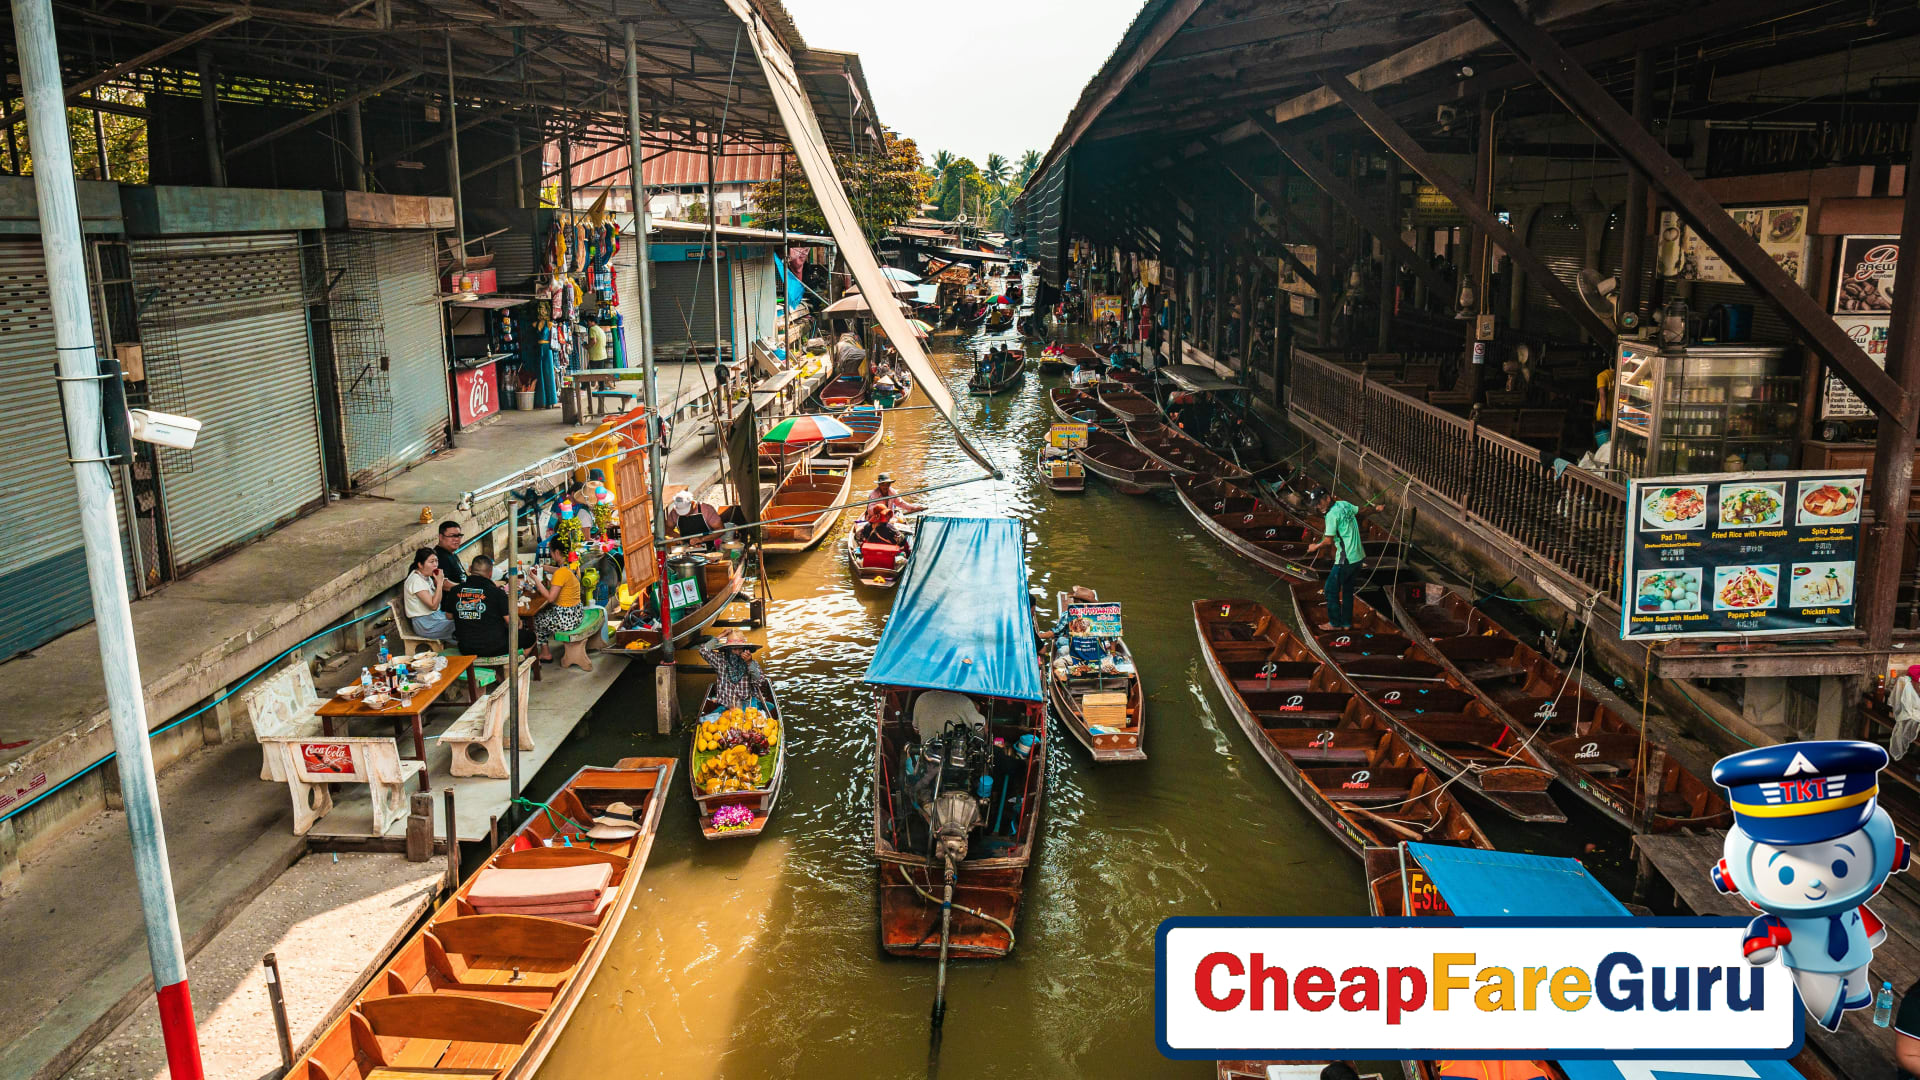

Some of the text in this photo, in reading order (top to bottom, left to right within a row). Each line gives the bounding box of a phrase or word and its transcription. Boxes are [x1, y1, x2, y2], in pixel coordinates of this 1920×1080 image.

[1857, 263, 1897, 271] PAEW
[1711, 531, 1728, 539] Fried
[1743, 530, 1757, 538] with
[1758, 529, 1788, 538] Pineapple
[1811, 526, 1845, 536] Spicy Soup
[1674, 532, 1688, 540] Thai
[1727, 610, 1767, 620] Papaya Salad
[1801, 607, 1841, 616] Chicken Rice
[1655, 615, 1669, 623] Soup
[1670, 614, 1682, 622] with
[1575, 751, 1600, 759] PAEW
